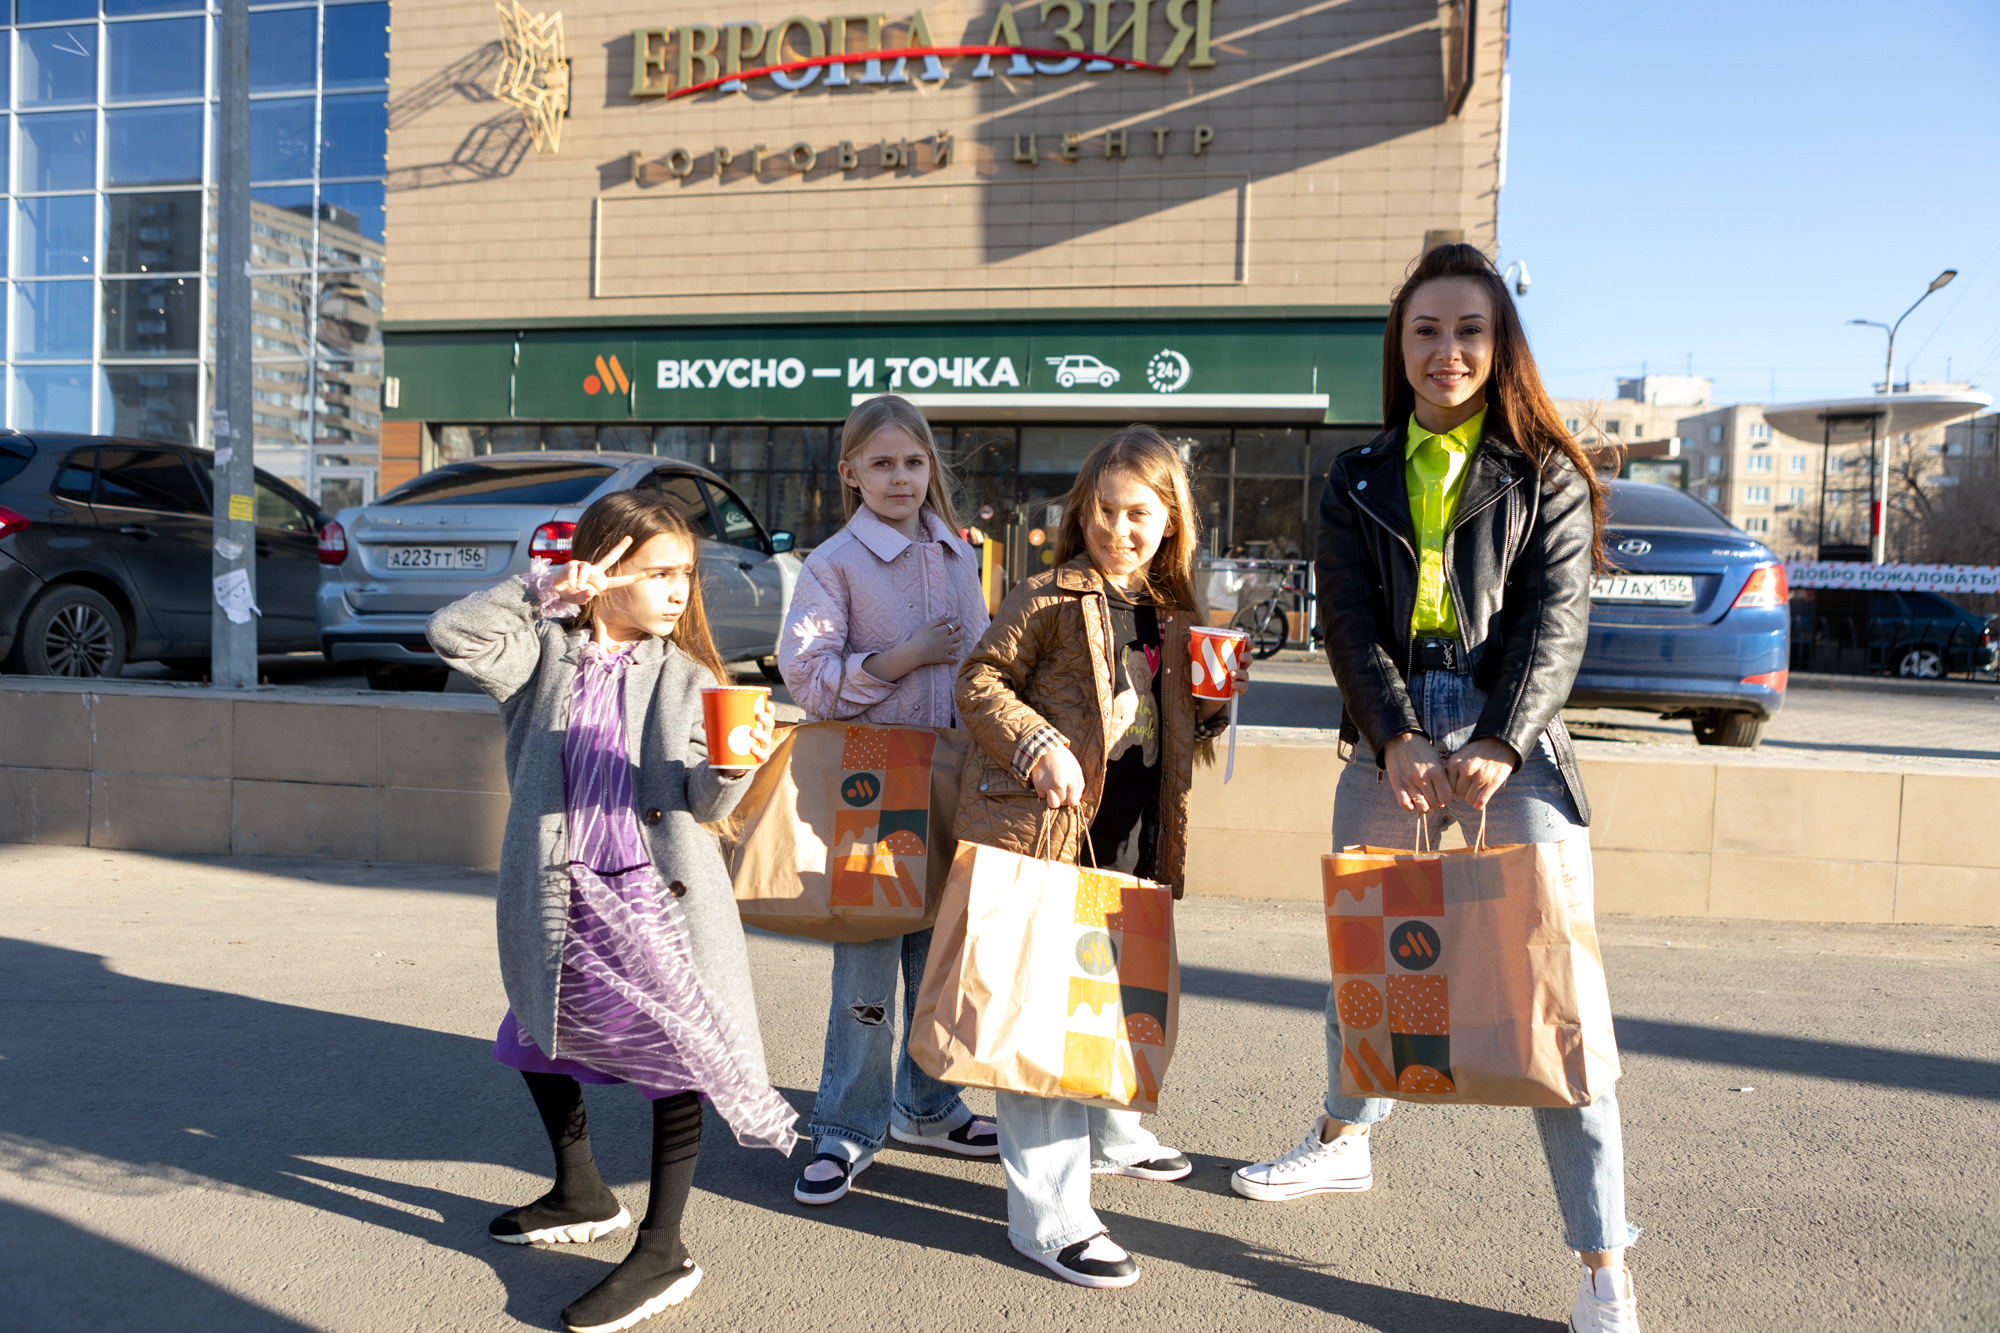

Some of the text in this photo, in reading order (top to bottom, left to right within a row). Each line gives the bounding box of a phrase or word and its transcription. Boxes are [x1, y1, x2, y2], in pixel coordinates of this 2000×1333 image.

[629, 0, 1216, 97] ЕВРОПА АЗИЯ
[628, 124, 1214, 180] ТОРГОВЫЙ ЦЕНТР
[656, 357, 806, 389] ВКУСНО
[848, 358, 875, 387] И
[884, 357, 1020, 388] ТОЧКА
[457, 548, 481, 562] 156
[1659, 579, 1687, 593] 156
[1792, 568, 1854, 581] ДОБРО
